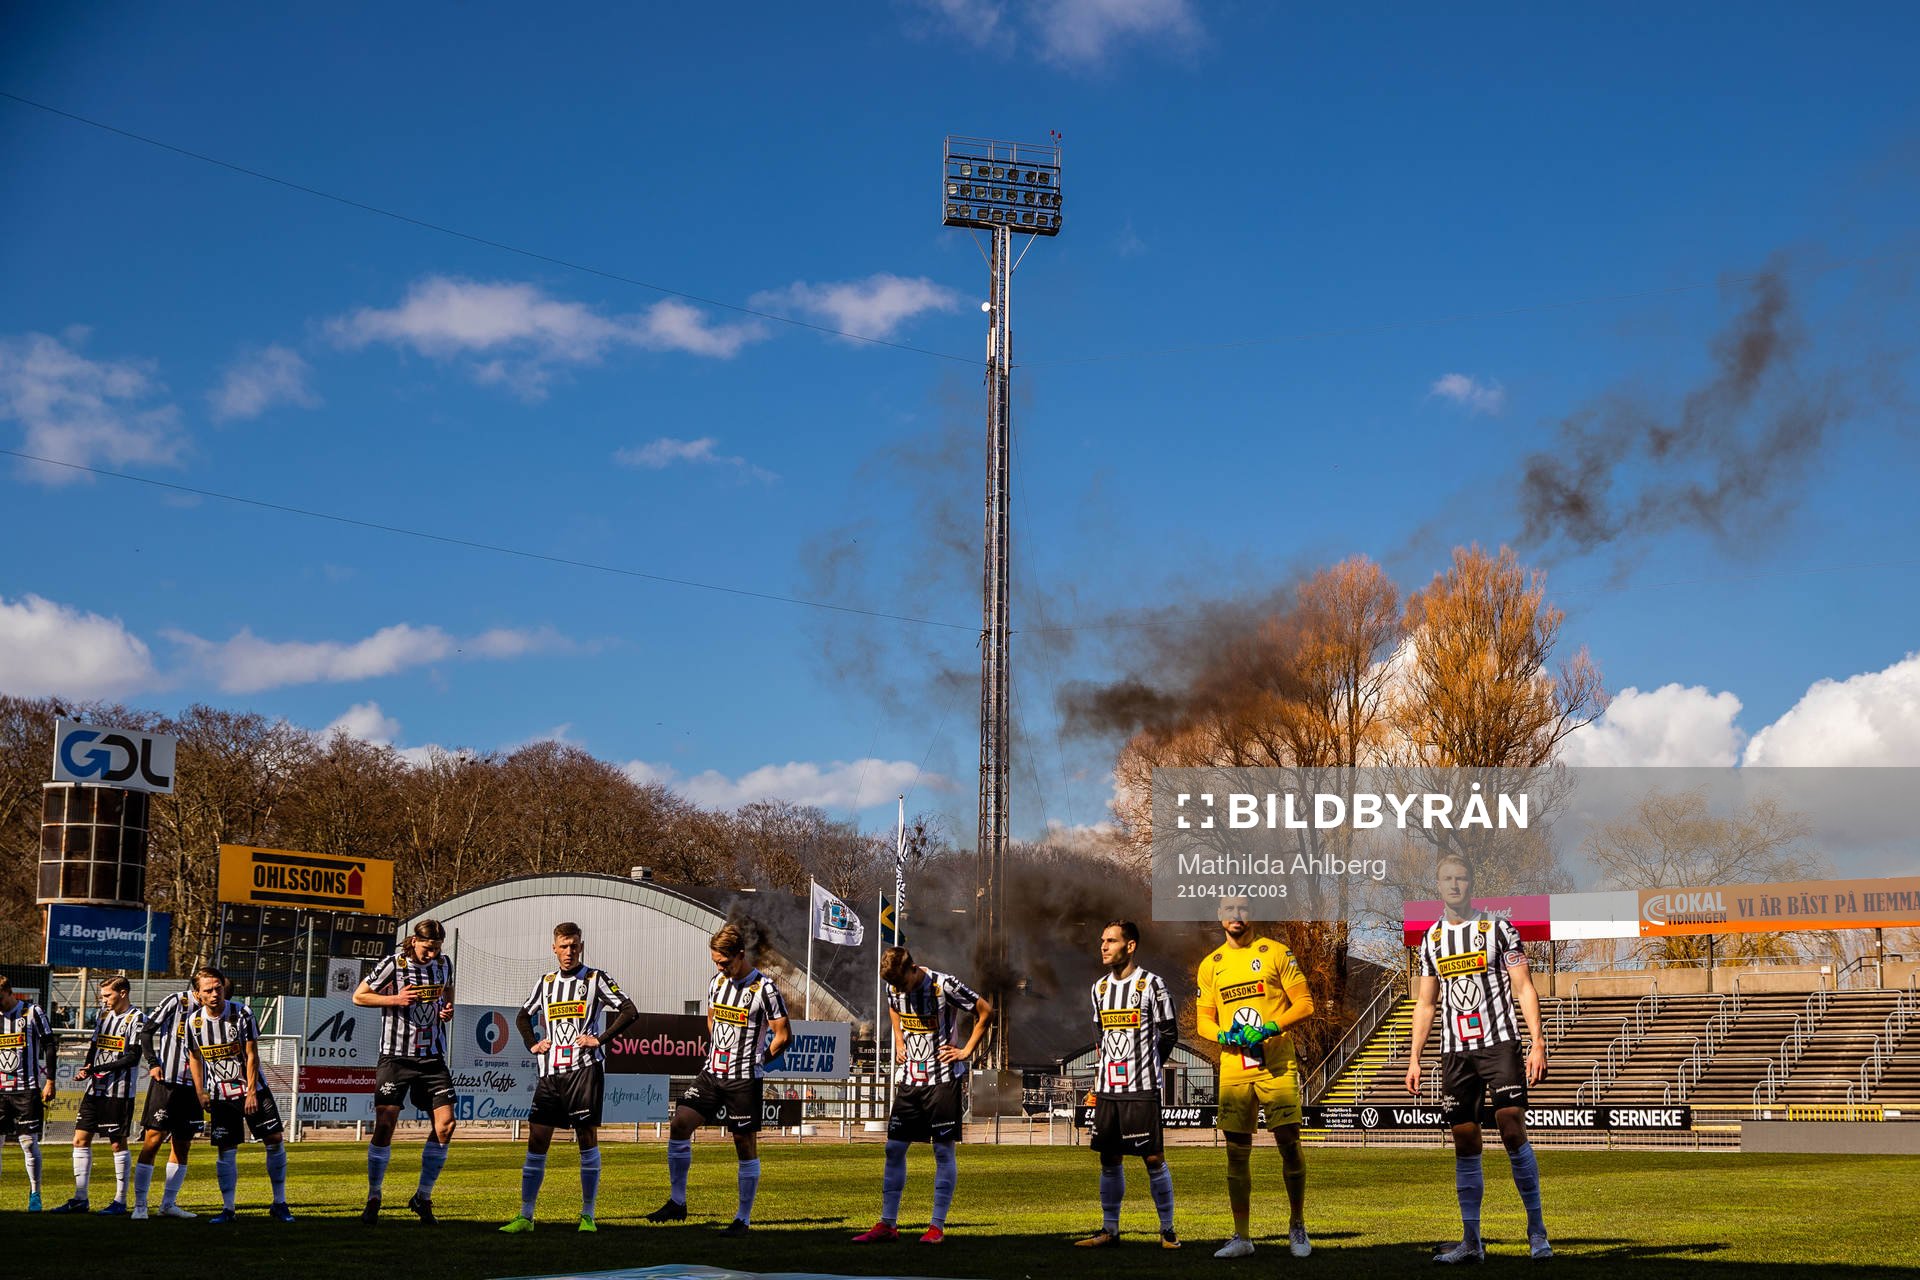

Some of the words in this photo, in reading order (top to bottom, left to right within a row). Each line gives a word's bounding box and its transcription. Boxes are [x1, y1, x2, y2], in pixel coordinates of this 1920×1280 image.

[60, 730, 170, 788] GDL
[253, 863, 347, 895] OHLSSONS
[1665, 891, 1727, 914] LOKAL
[1737, 898, 1754, 918] VI
[1760, 893, 1782, 916] ÄR
[1787, 892, 1829, 915] BÄST
[1834, 891, 1857, 913] PÅ
[1667, 912, 1727, 926] TIDNINGEN
[72, 924, 157, 942] BorgWarner
[611, 1034, 708, 1057] Swedbank
[816, 1054, 834, 1073] AB
[317, 1074, 377, 1085] www.mullvadarn
[302, 1093, 348, 1113] MÖBLER
[762, 1100, 781, 1120] tor
[1393, 1108, 1442, 1125] Volksw
[1525, 1109, 1596, 1127] SERNEKE
[1608, 1109, 1684, 1127] SERNEKE
